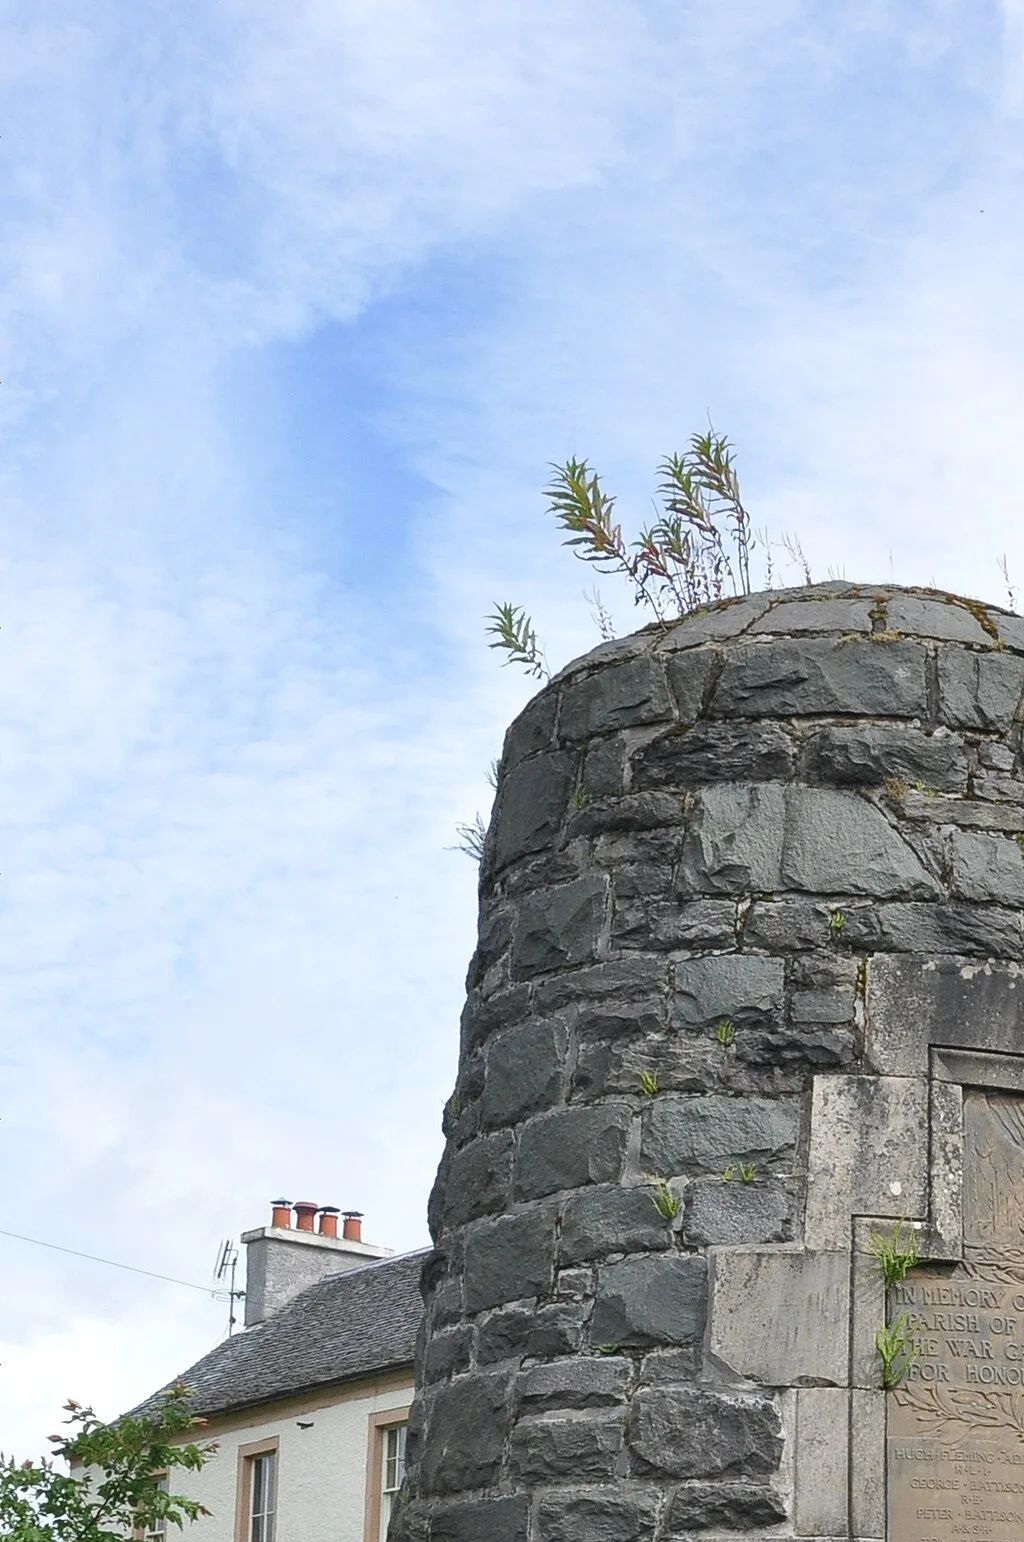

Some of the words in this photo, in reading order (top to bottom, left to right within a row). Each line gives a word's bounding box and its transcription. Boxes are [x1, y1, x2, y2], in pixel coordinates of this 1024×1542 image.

[896, 1286, 915, 1305] IN
[922, 1287, 1004, 1308] MEMORY
[906, 1313, 980, 1333] PARISH
[990, 1316, 1016, 1336] OF
[898, 1337, 939, 1356] THE
[946, 1339, 994, 1359] WAR
[908, 1363, 950, 1383] FOR
[895, 1449, 934, 1461] HUGH
[909, 1478, 960, 1491] GEORGE
[916, 1508, 953, 1520] PETER
